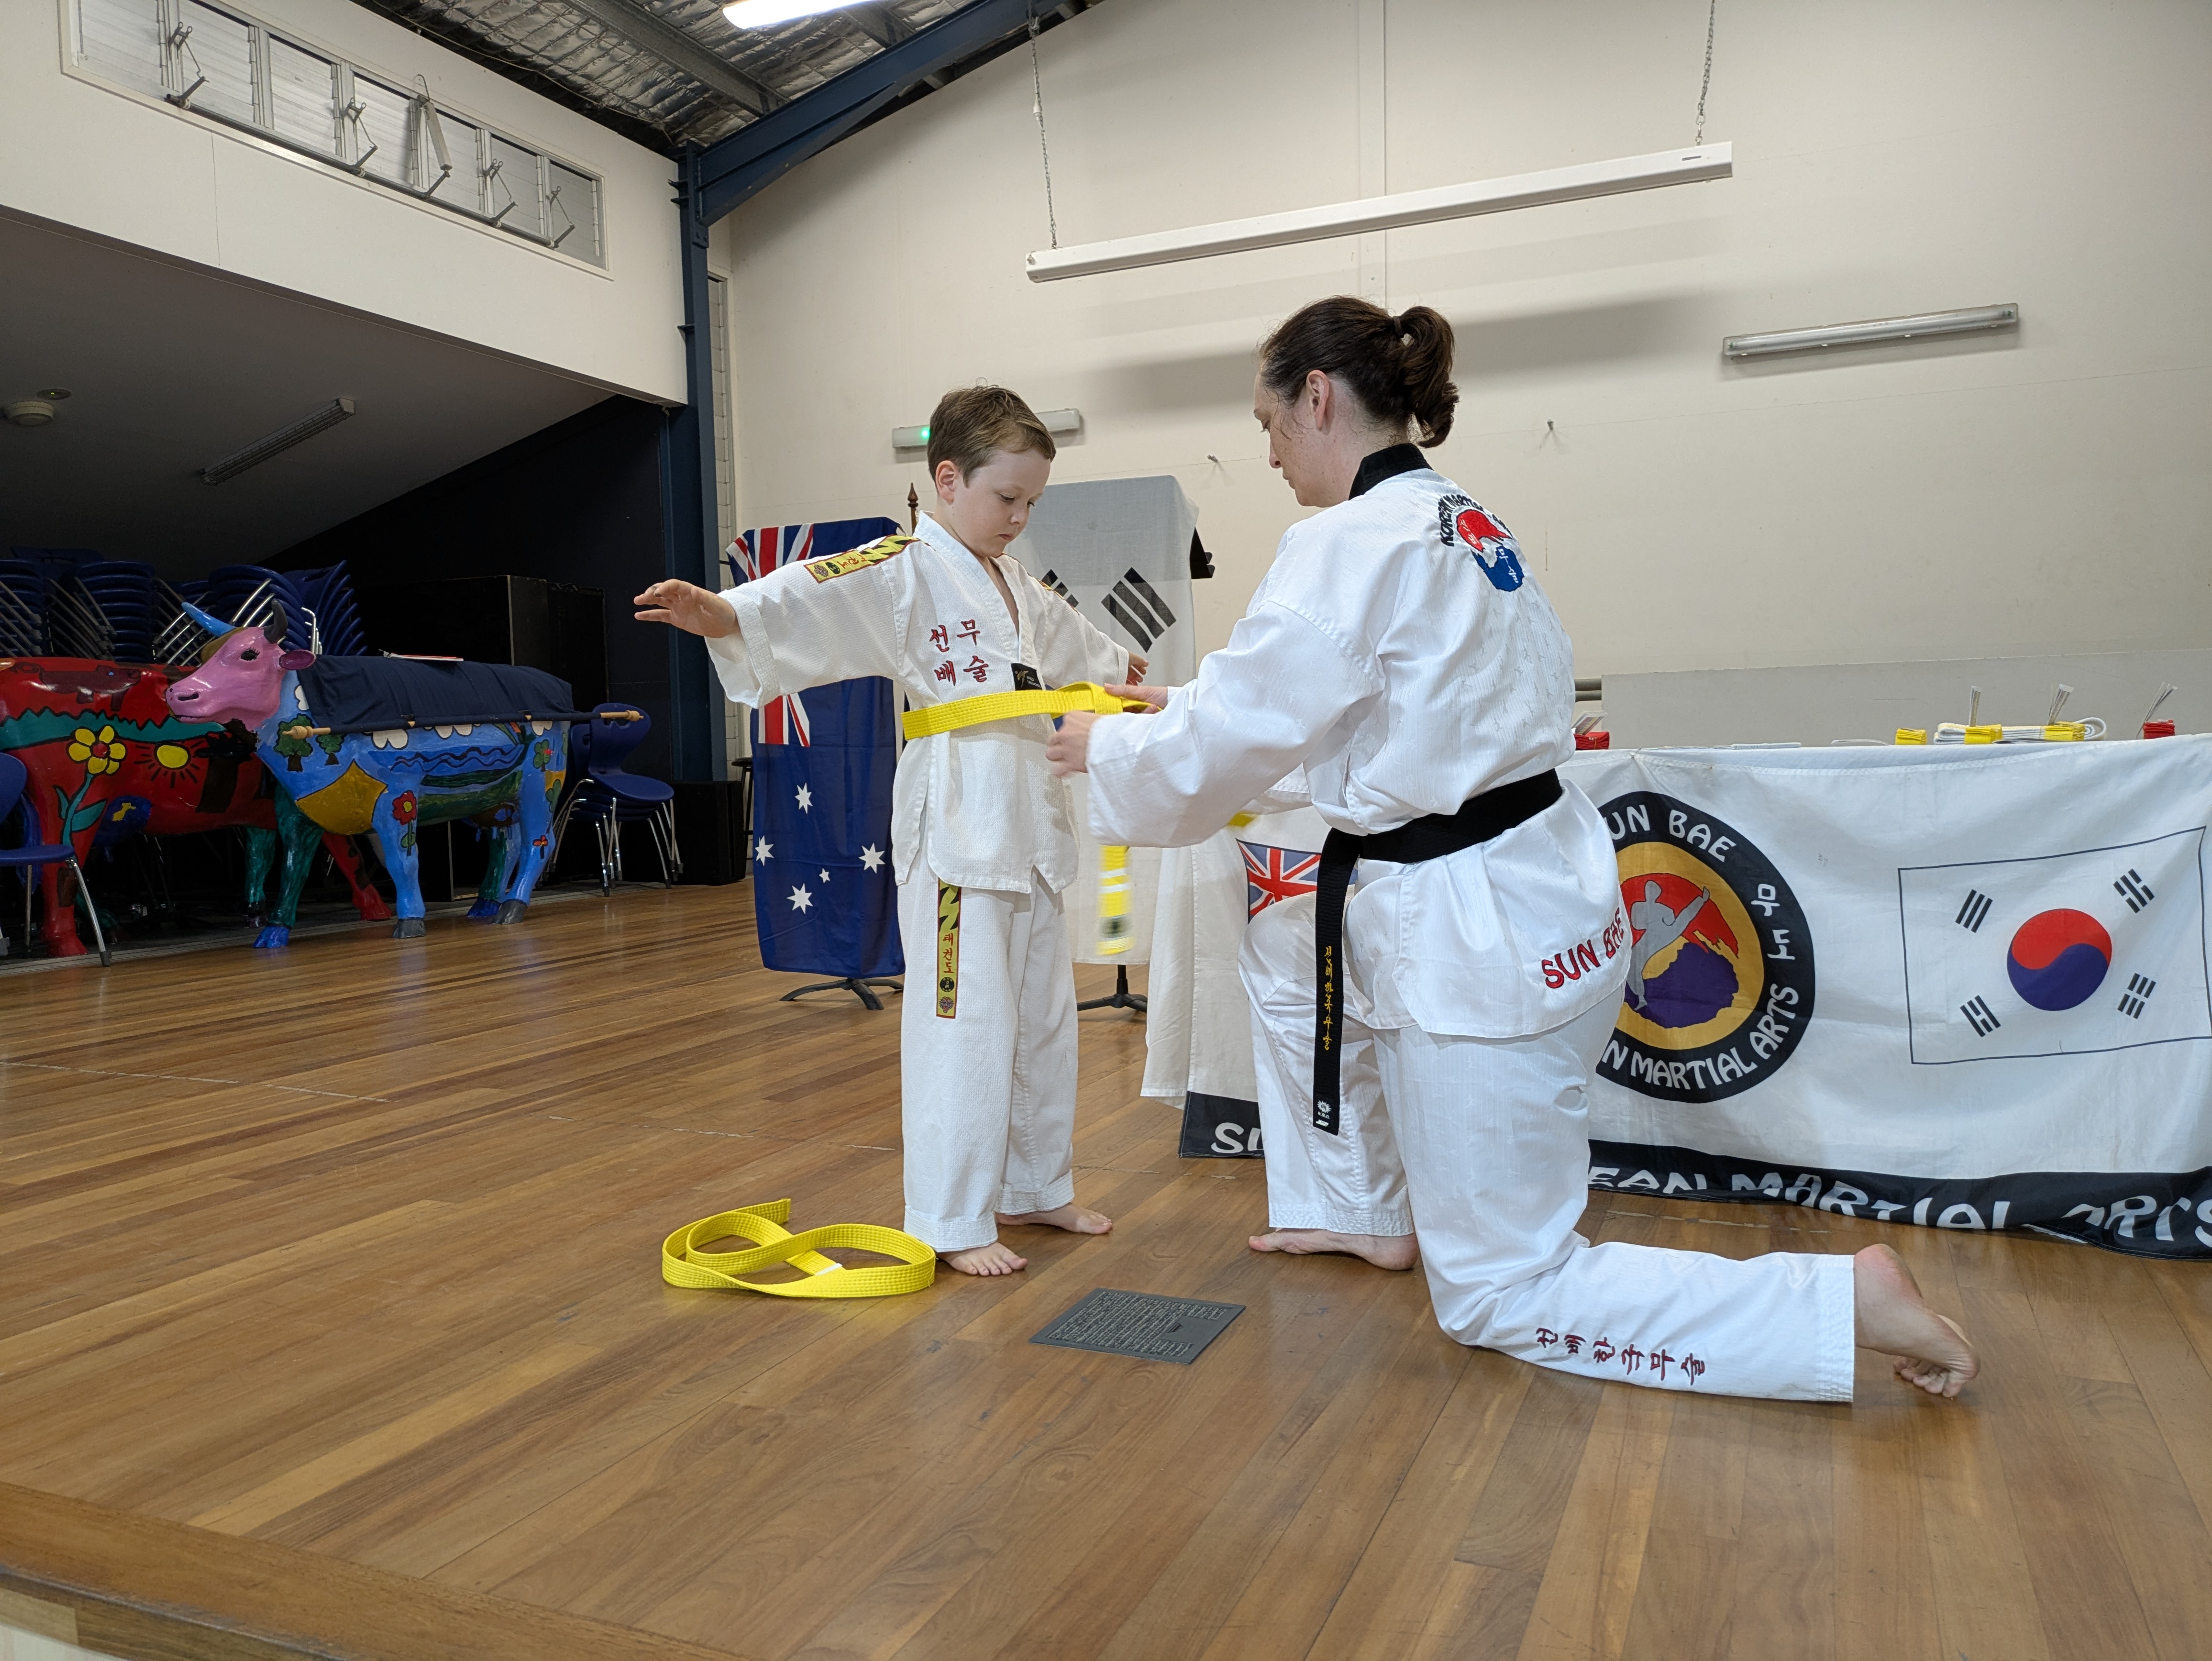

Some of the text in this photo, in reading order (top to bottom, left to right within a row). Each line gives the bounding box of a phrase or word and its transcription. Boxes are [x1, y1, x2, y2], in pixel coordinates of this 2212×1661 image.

[1604, 804, 1737, 863] UN BAE
[943, 932, 954, 974] 태권도
[1541, 907, 1624, 989] SUN BAE
[1630, 1051, 1758, 1090] MARTIAL
[1749, 983, 1799, 1060] ARTS
[1588, 1166, 1707, 1194] EAN
